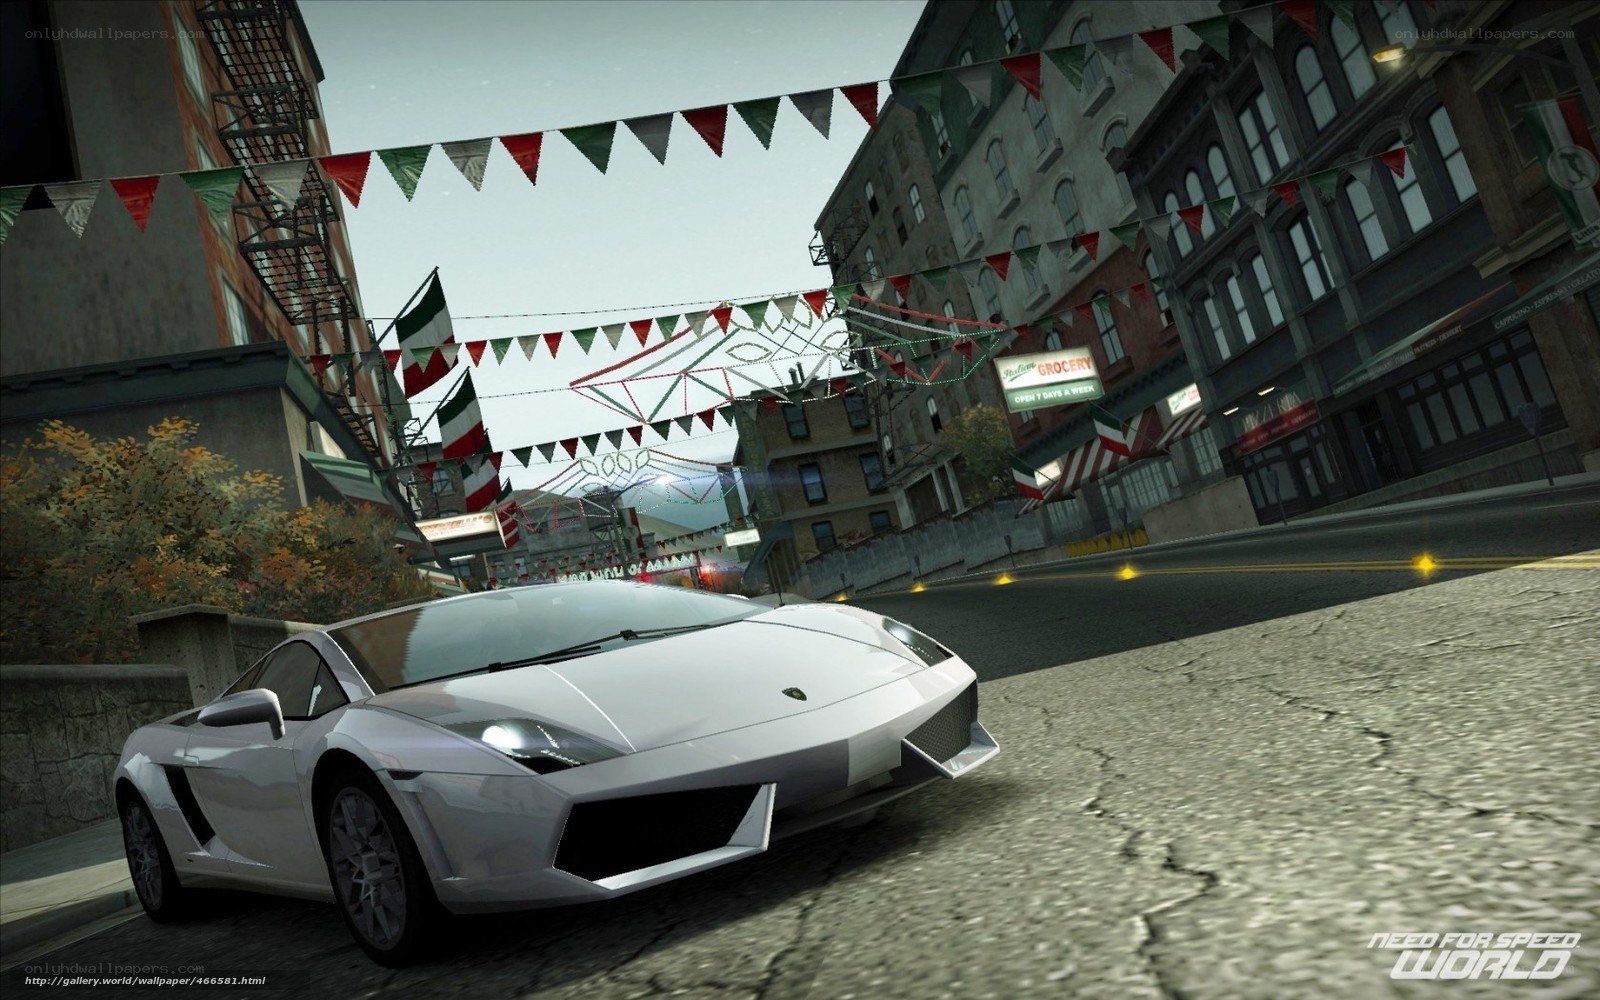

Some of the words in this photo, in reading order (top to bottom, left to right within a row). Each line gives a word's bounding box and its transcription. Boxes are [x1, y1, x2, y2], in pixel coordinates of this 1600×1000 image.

[1003, 361, 1036, 379] Italian
[1037, 356, 1092, 376] GROCERY
[1014, 394, 1035, 404] OPEN
[1043, 391, 1063, 400] DAYS
[1071, 385, 1095, 395] WEEK
